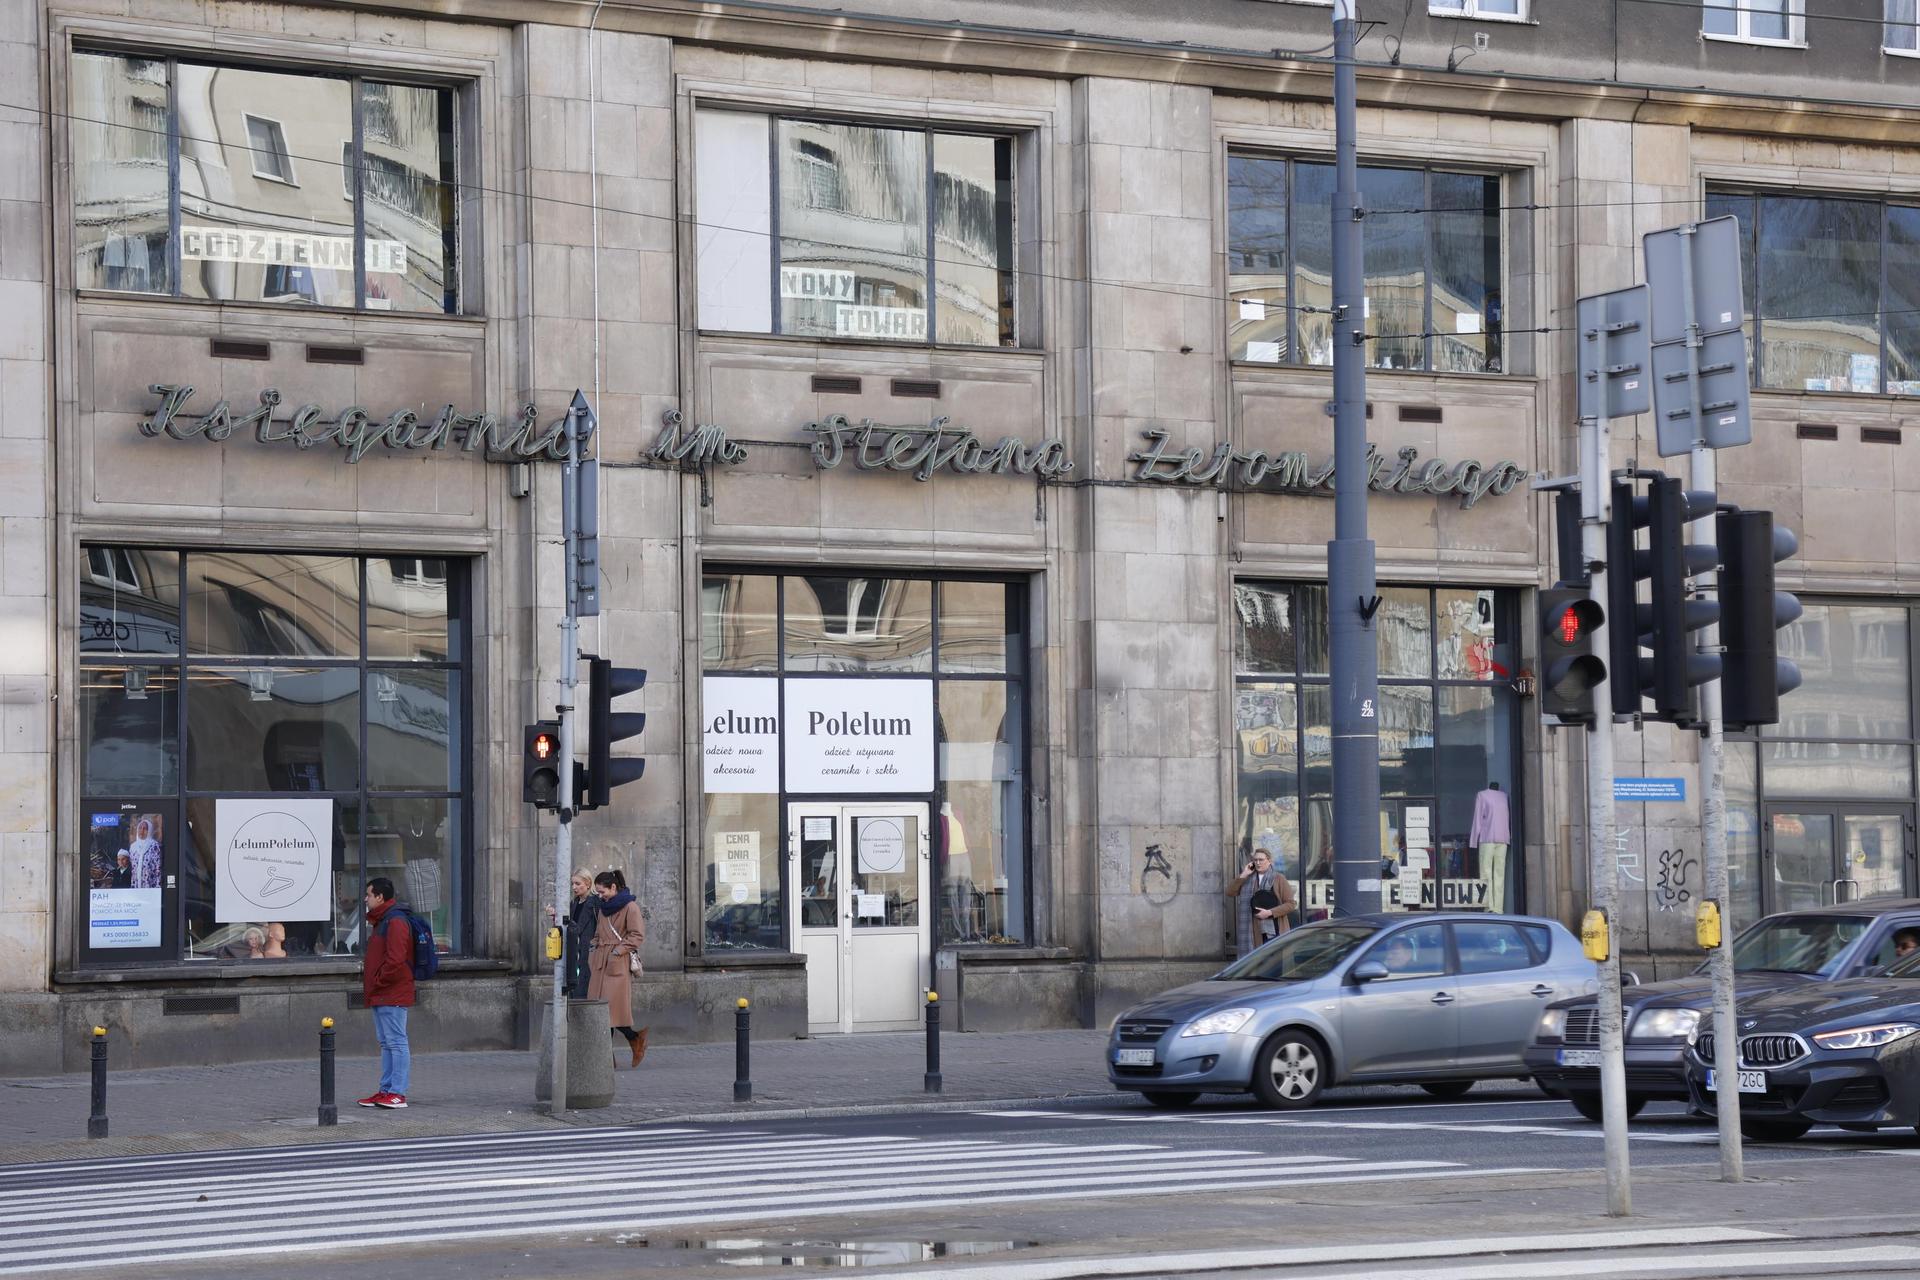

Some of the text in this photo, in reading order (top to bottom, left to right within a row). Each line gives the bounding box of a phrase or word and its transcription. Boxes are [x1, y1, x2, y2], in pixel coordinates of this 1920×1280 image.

[782, 271, 853, 297] NOWY
[839, 309, 926, 335] TOWAR
[802, 413, 1076, 483] Stefana
[1127, 428, 1529, 511] Żeromkiego
[1362, 699, 1373, 708] 47
[808, 710, 912, 736] Polelum
[705, 743, 763, 755] odzież nowa
[824, 744, 895, 760] odzież używana
[713, 763, 756, 775] akcesoria
[821, 763, 861, 776] ceramika
[874, 763, 899, 776] szkło
[234, 838, 315, 849] LelumPolelum
[726, 834, 750, 845] CENA
[727, 849, 749, 860] DNIA
[1421, 882, 1488, 905] NOWY
